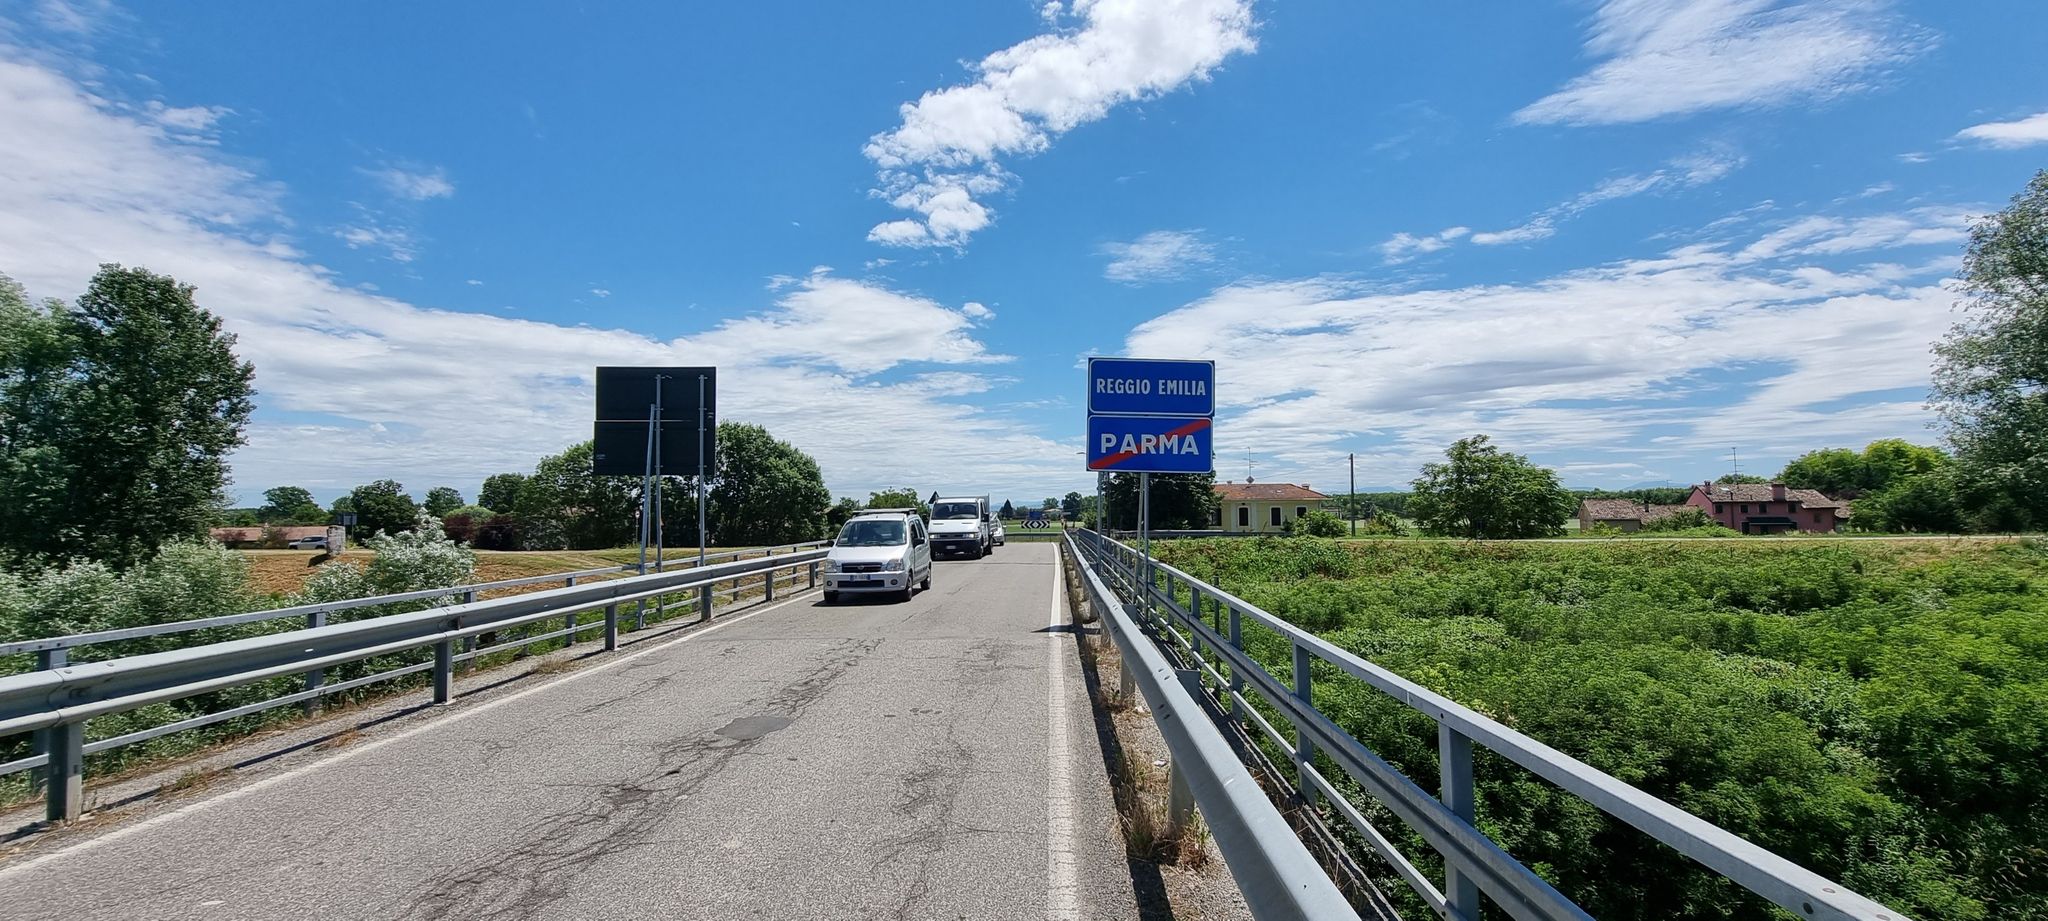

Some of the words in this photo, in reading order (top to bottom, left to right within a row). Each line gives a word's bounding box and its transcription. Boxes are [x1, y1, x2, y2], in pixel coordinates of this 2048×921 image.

[1096, 378, 1151, 395] REGGIO
[1158, 379, 1206, 396] EMILIA
[1100, 433, 1199, 455] PARMA
